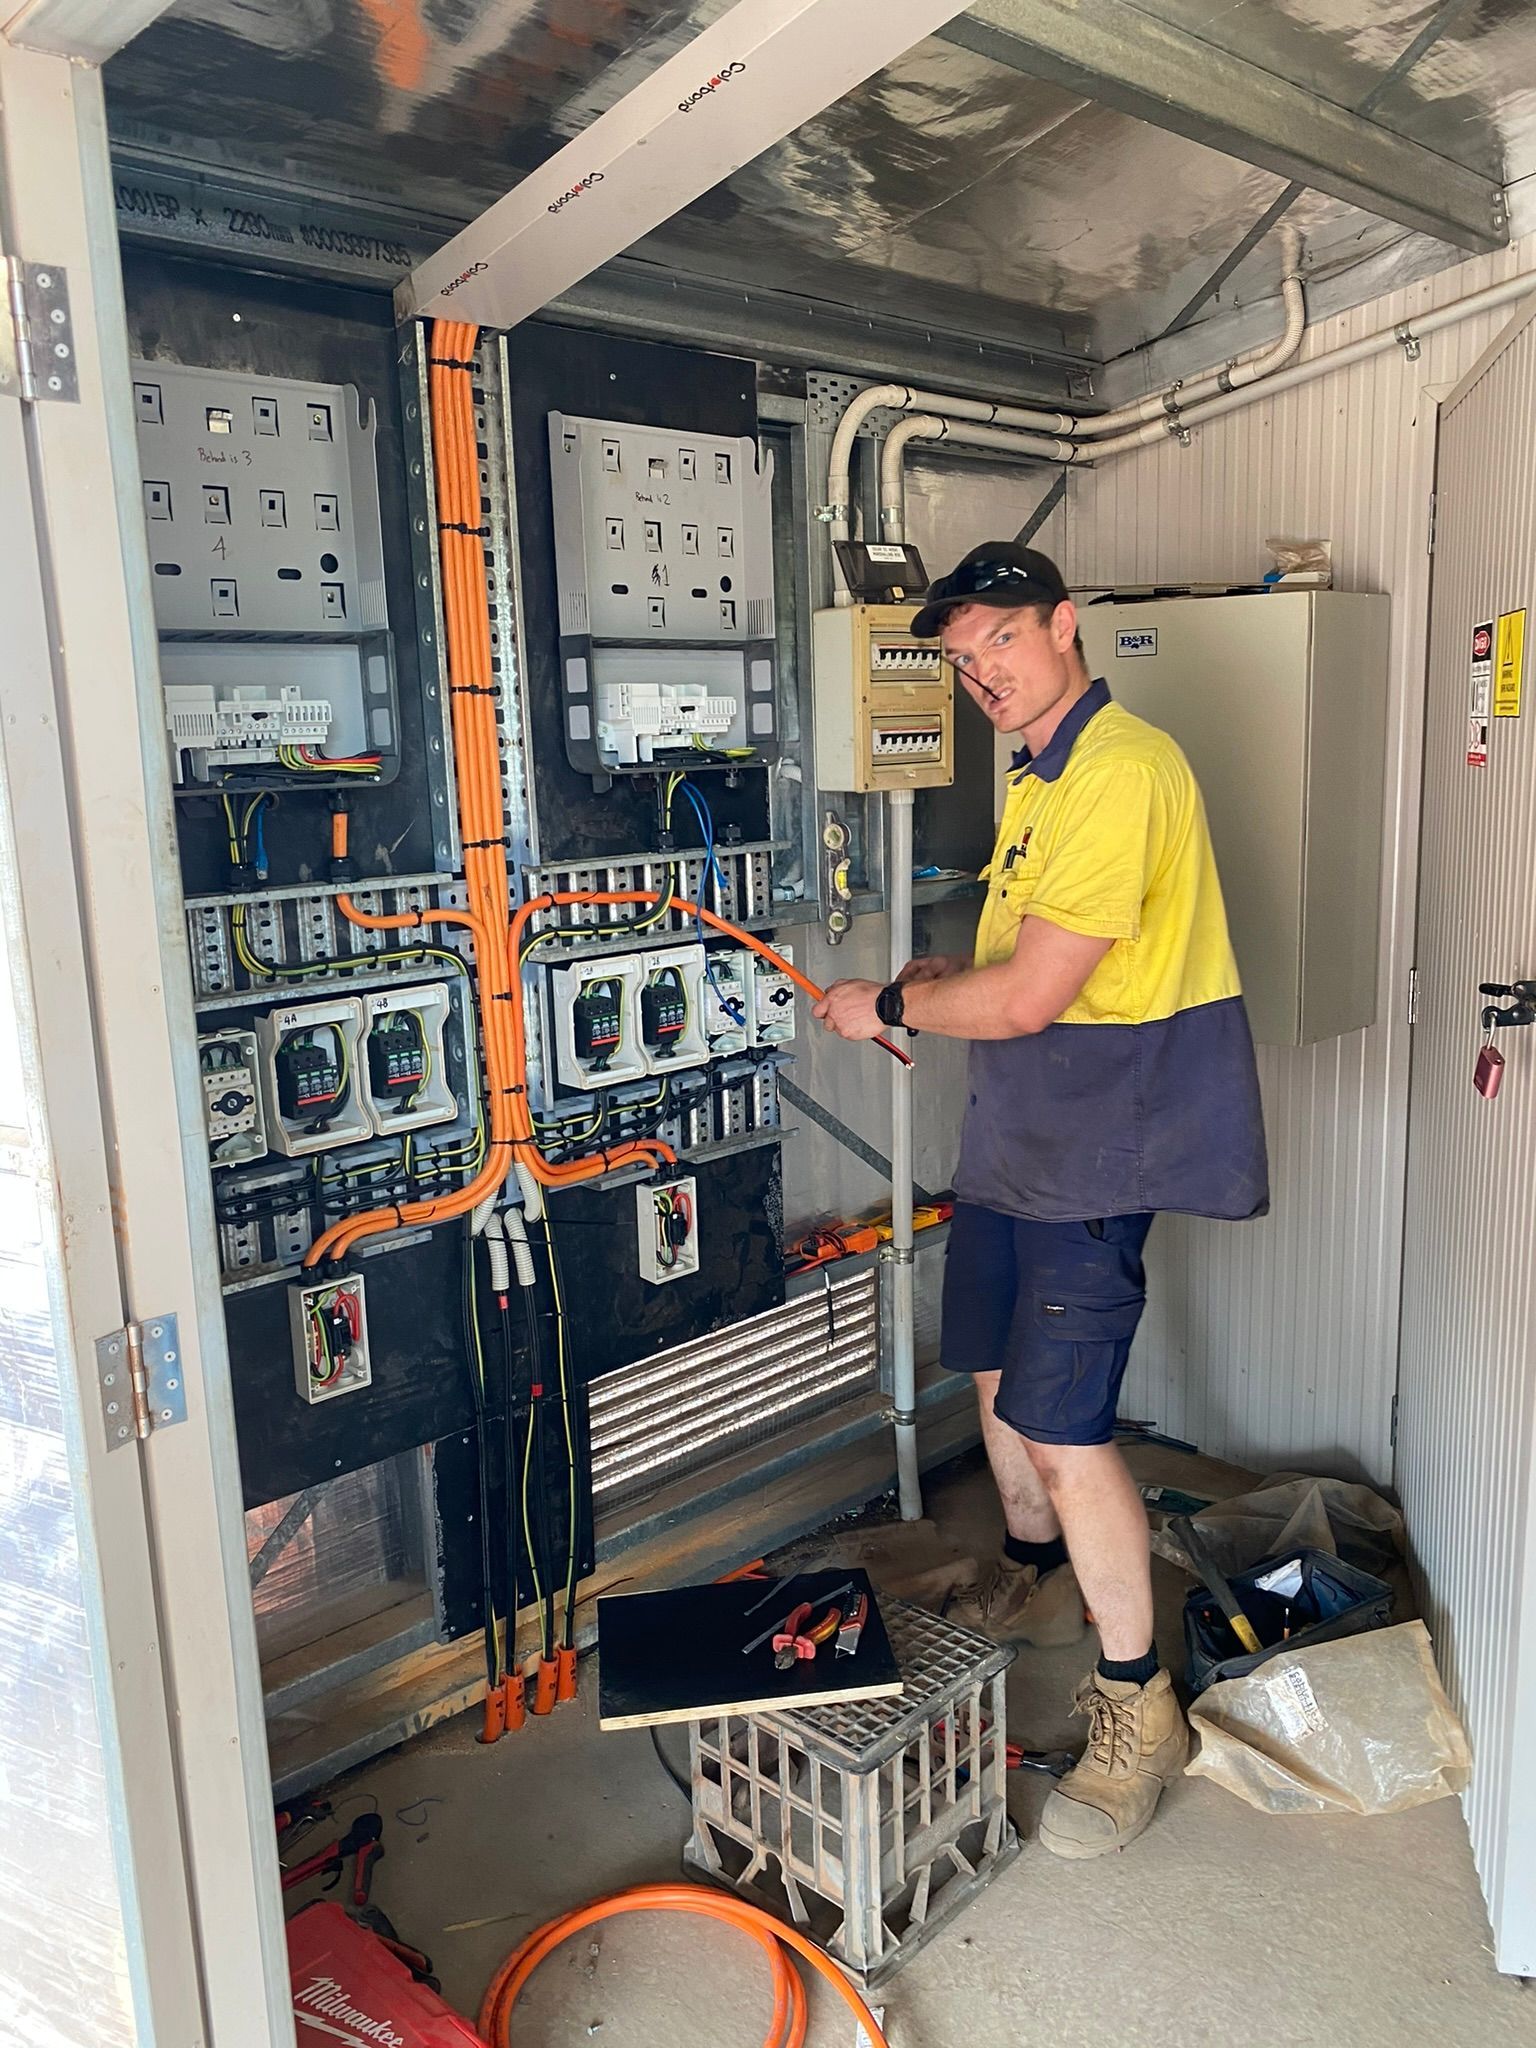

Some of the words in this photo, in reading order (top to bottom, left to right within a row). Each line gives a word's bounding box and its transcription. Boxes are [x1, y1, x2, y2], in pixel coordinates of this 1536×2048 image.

[678, 61, 746, 113] Colorbond
[548, 172, 604, 214] Colorbond
[241, 450, 253, 466] 3
[662, 493, 671, 506] 2
[211, 535, 227, 561] 4
[1119, 635, 1154, 648] B&R
[376, 997, 389, 1009] 4B
[284, 1013, 298, 1026] 4A
[294, 1977, 404, 2048] Milwaukee
